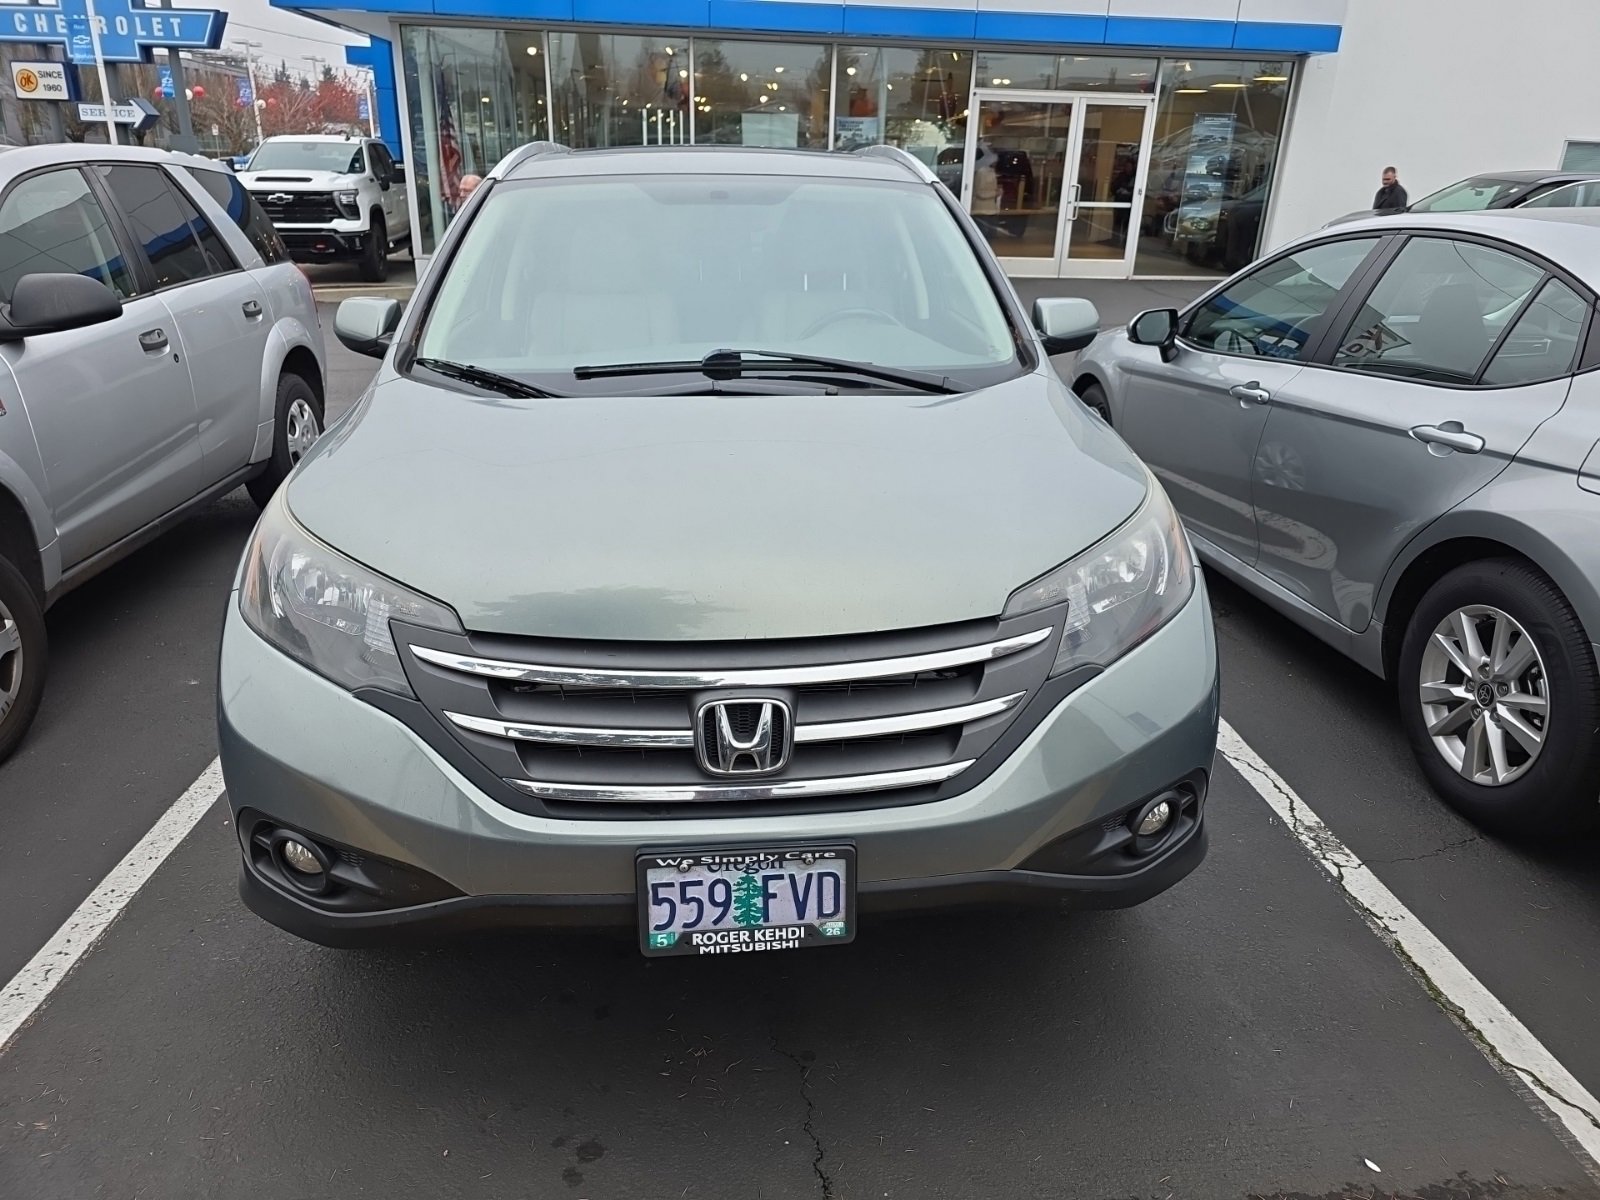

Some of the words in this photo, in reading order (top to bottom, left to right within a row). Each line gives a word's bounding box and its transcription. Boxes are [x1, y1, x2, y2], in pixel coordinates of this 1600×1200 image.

[13, 12, 181, 37] CHEROLET
[20, 73, 34, 87] OK
[37, 70, 63, 79] SINCE
[81, 107, 136, 118] SERICE
[656, 857, 694, 867] We
[700, 852, 779, 864] Simply
[784, 851, 836, 859] Care
[650, 878, 733, 931] 559
[762, 871, 841, 924] FVD
[692, 928, 752, 946] ROGER
[754, 926, 805, 942] KEHDI
[826, 928, 841, 936] 26
[656, 933, 668, 947] 5
[699, 939, 799, 955] MITSUBISHI
